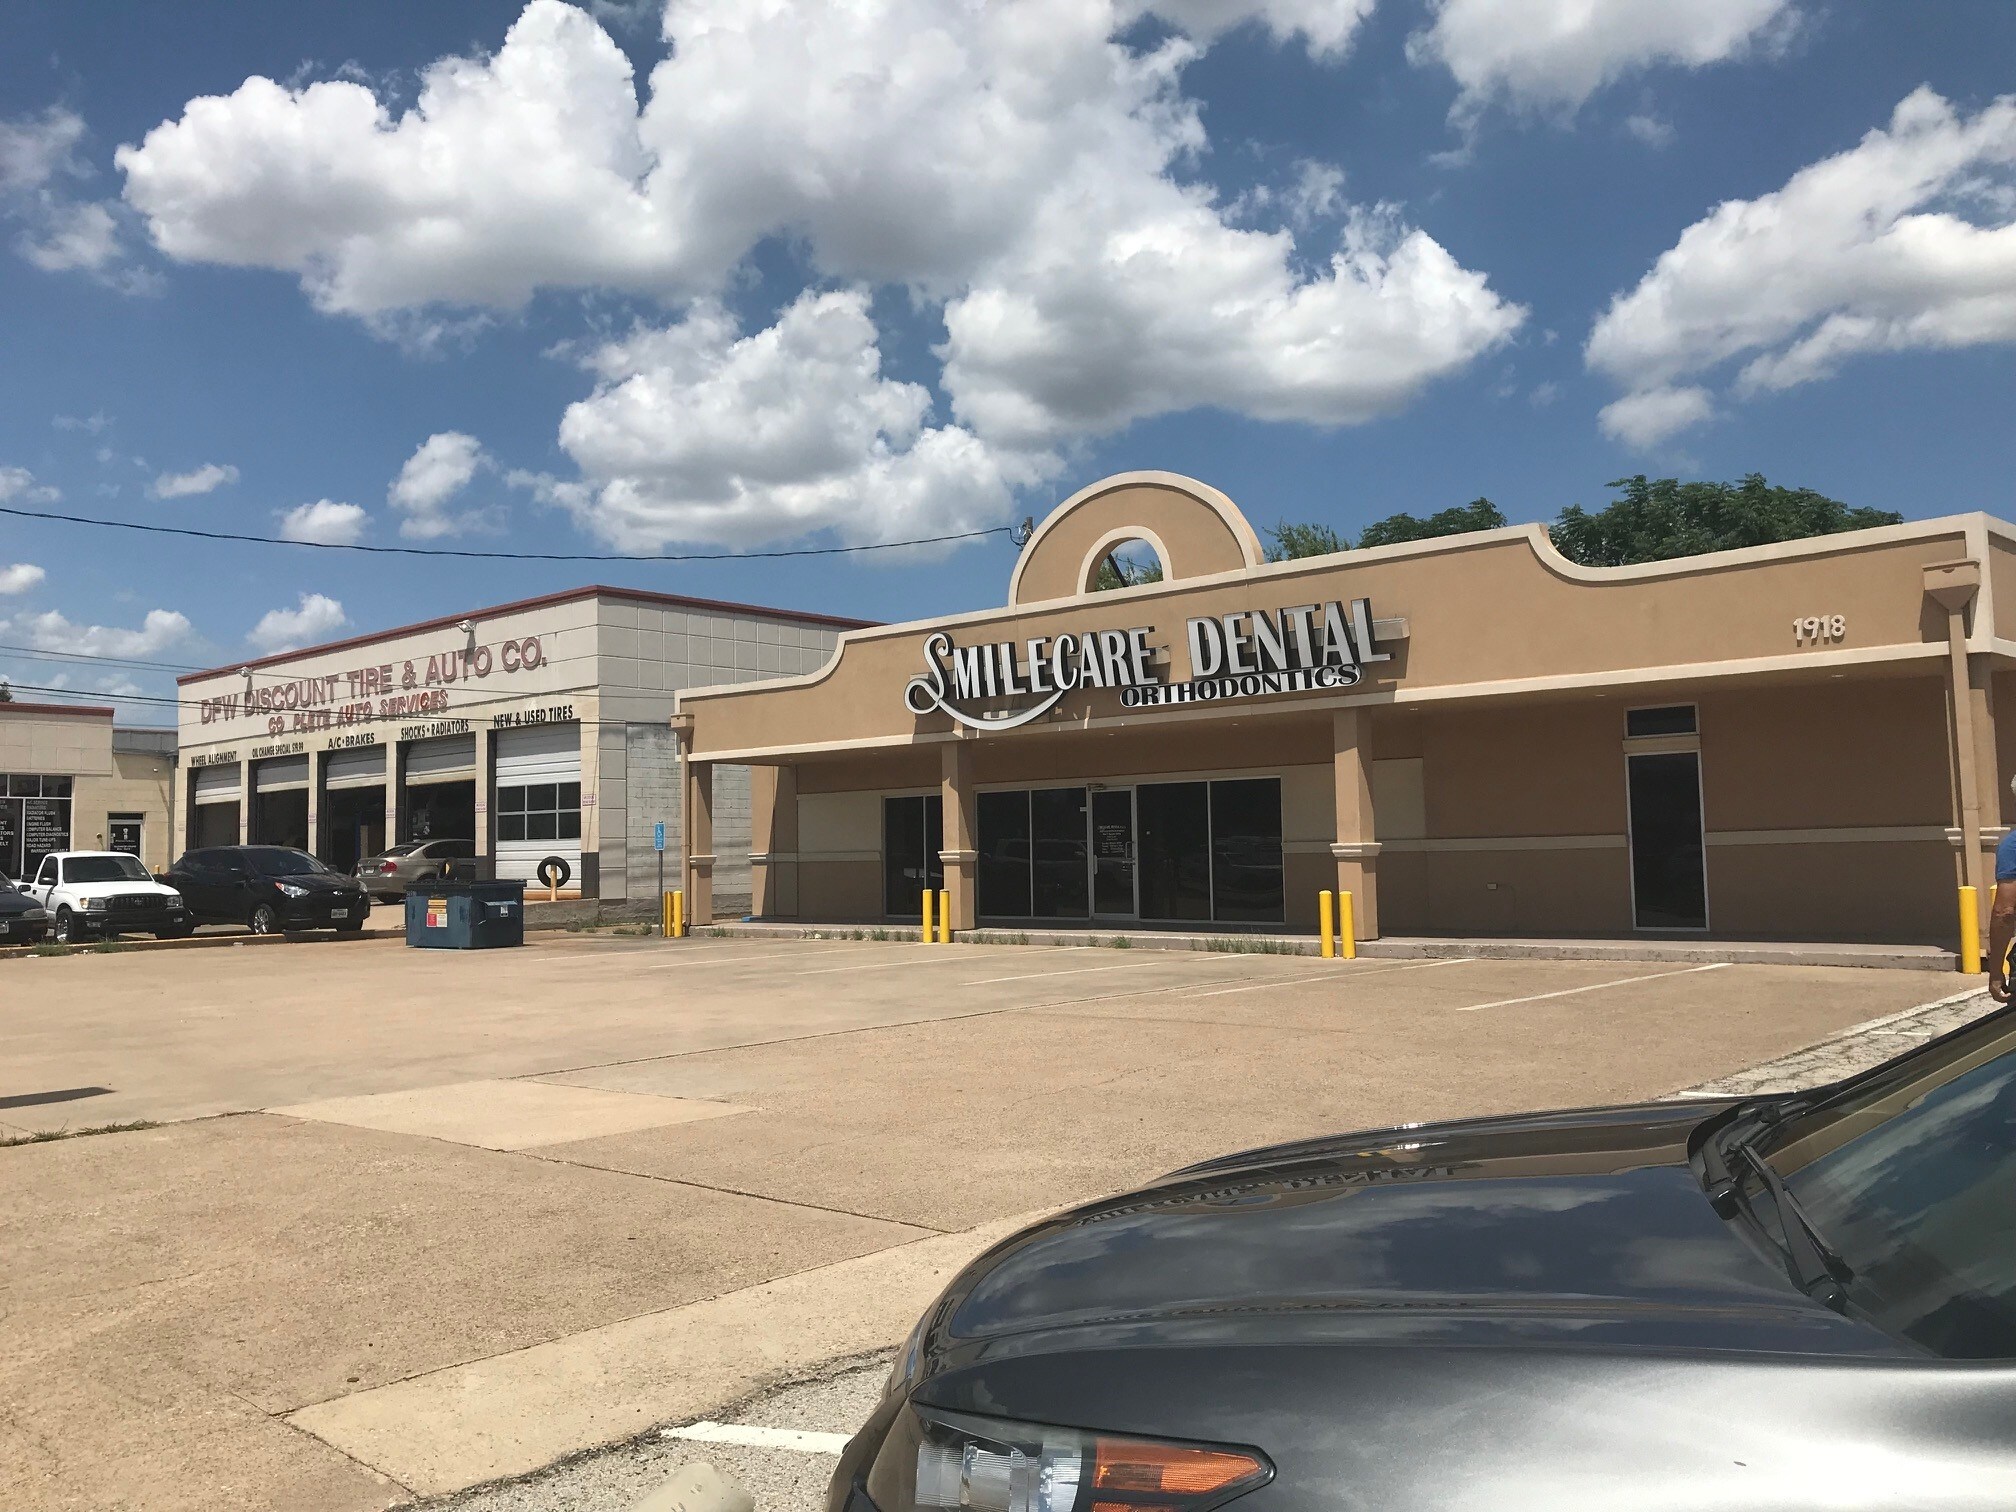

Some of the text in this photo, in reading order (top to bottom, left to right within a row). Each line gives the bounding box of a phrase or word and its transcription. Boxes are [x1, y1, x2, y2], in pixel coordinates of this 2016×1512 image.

[1793, 614, 1846, 641] 1918
[904, 598, 1395, 730] SMILECARE DENTAL
[201, 636, 548, 725] DFW DISCOUNT TIRE & AUTO CO.
[1121, 664, 1359, 707] ORTHODONTICS
[336, 701, 373, 730] AUTO
[379, 689, 448, 722] SERVICES
[493, 704, 573, 728] NEW & USED TIRES
[345, 732, 375, 747] BRAKES
[400, 719, 469, 741] SHOCKS RADIATORS
[191, 751, 237, 767] WHEEL ALIGNMENT
[259, 746, 275, 757] CHANGE
[275, 743, 291, 755] SPECIAL
